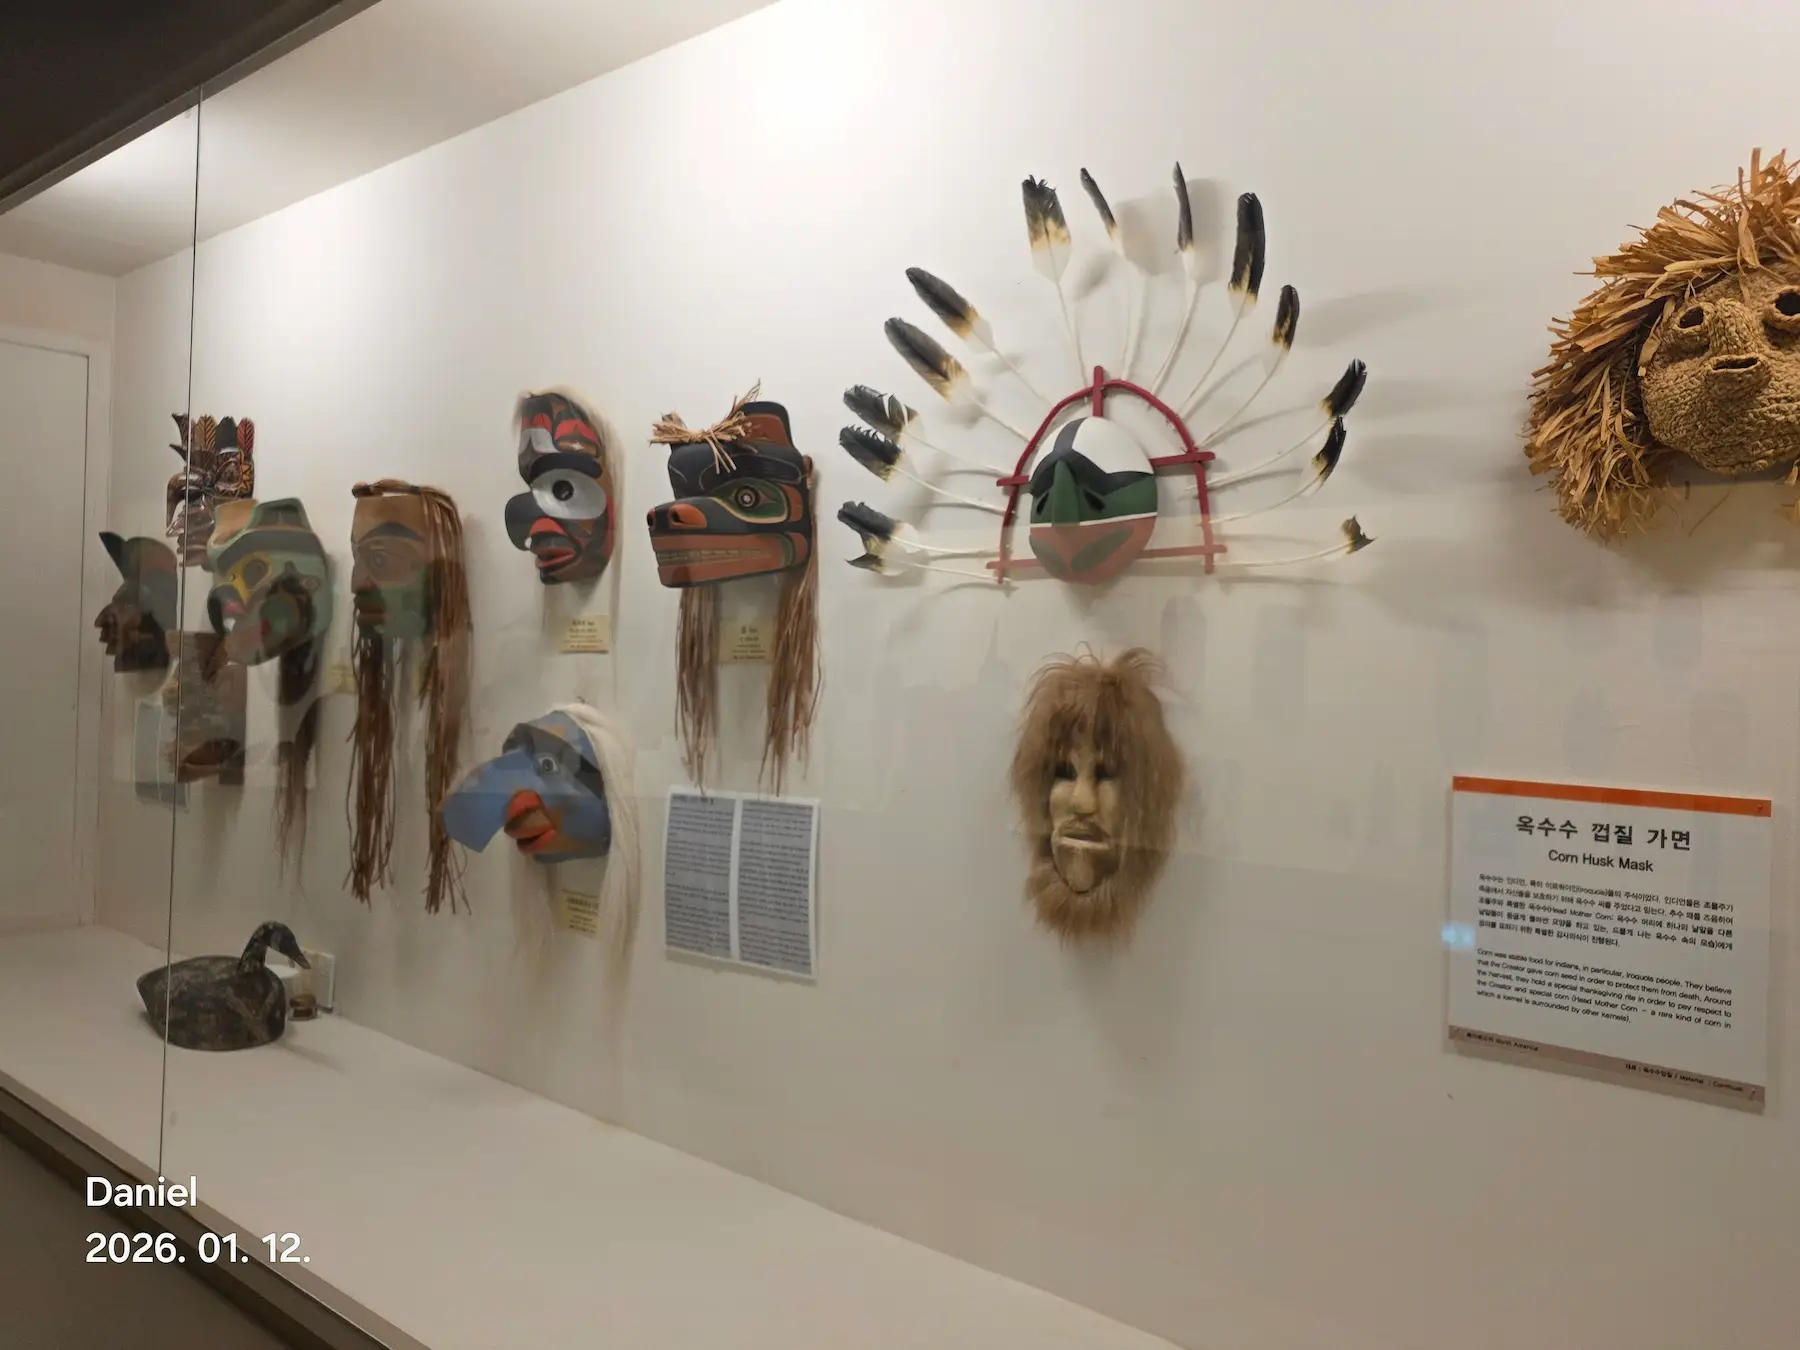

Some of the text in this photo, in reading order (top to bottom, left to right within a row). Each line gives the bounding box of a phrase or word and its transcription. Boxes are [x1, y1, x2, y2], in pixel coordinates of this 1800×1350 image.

[1515, 815, 1690, 851] 옥수수 껍질 가면
[1548, 849, 1653, 872] Corn Husk Mask
[1575, 897, 1596, 907] 옥수수
[1613, 902, 1641, 912] 주었다고
[1669, 909, 1684, 919] 추수
[1664, 896, 1701, 908] 인디언들은
[1575, 921, 1589, 930] 하고
[1637, 930, 1652, 939] 나는
[1655, 932, 1677, 942] 옥수수
[1617, 914, 1638, 924] 옥수수
[1666, 921, 1688, 932] 하나의
[1477, 948, 1493, 957] Corn
[1544, 958, 1554, 966] for
[1590, 967, 1624, 978] particular,
[1655, 977, 1682, 987] people.
[1684, 980, 1704, 991] They
[1705, 984, 1732, 995] believe
[1515, 975, 1530, 984] they
[1531, 978, 1546, 986] hold
[1553, 982, 1578, 991] special
[1579, 986, 1623, 1000] thanksgiving
[1646, 998, 1666, 1006] order
[1677, 1003, 1692, 1012] pay
[1694, 1006, 1722, 1016] respect
[1724, 1010, 1732, 1018] to
[1560, 973, 1578, 981] seed
[1586, 977, 1606, 985] order
[1606, 979, 1614, 987] to
[1615, 982, 1640, 991] protect
[1641, 985, 1659, 994] them
[1660, 987, 1677, 997] from
[1678, 991, 1702, 1002] death.
[1703, 995, 1732, 1006] Around
[1529, 989, 1552, 997] special
[1571, 994, 1592, 1005] (Head
[1594, 999, 1618, 1009] Mother
[1620, 1003, 1638, 1012] Corn
[1658, 1011, 1673, 1019] rare
[1675, 1013, 1692, 1022] kind
[1704, 1019, 1722, 1027] corn
[1724, 1021, 1731, 1029] in
[1531, 1000, 1570, 1012] surrounded
[1571, 1006, 1580, 1014] by
[1581, 1008, 1600, 1016] other
